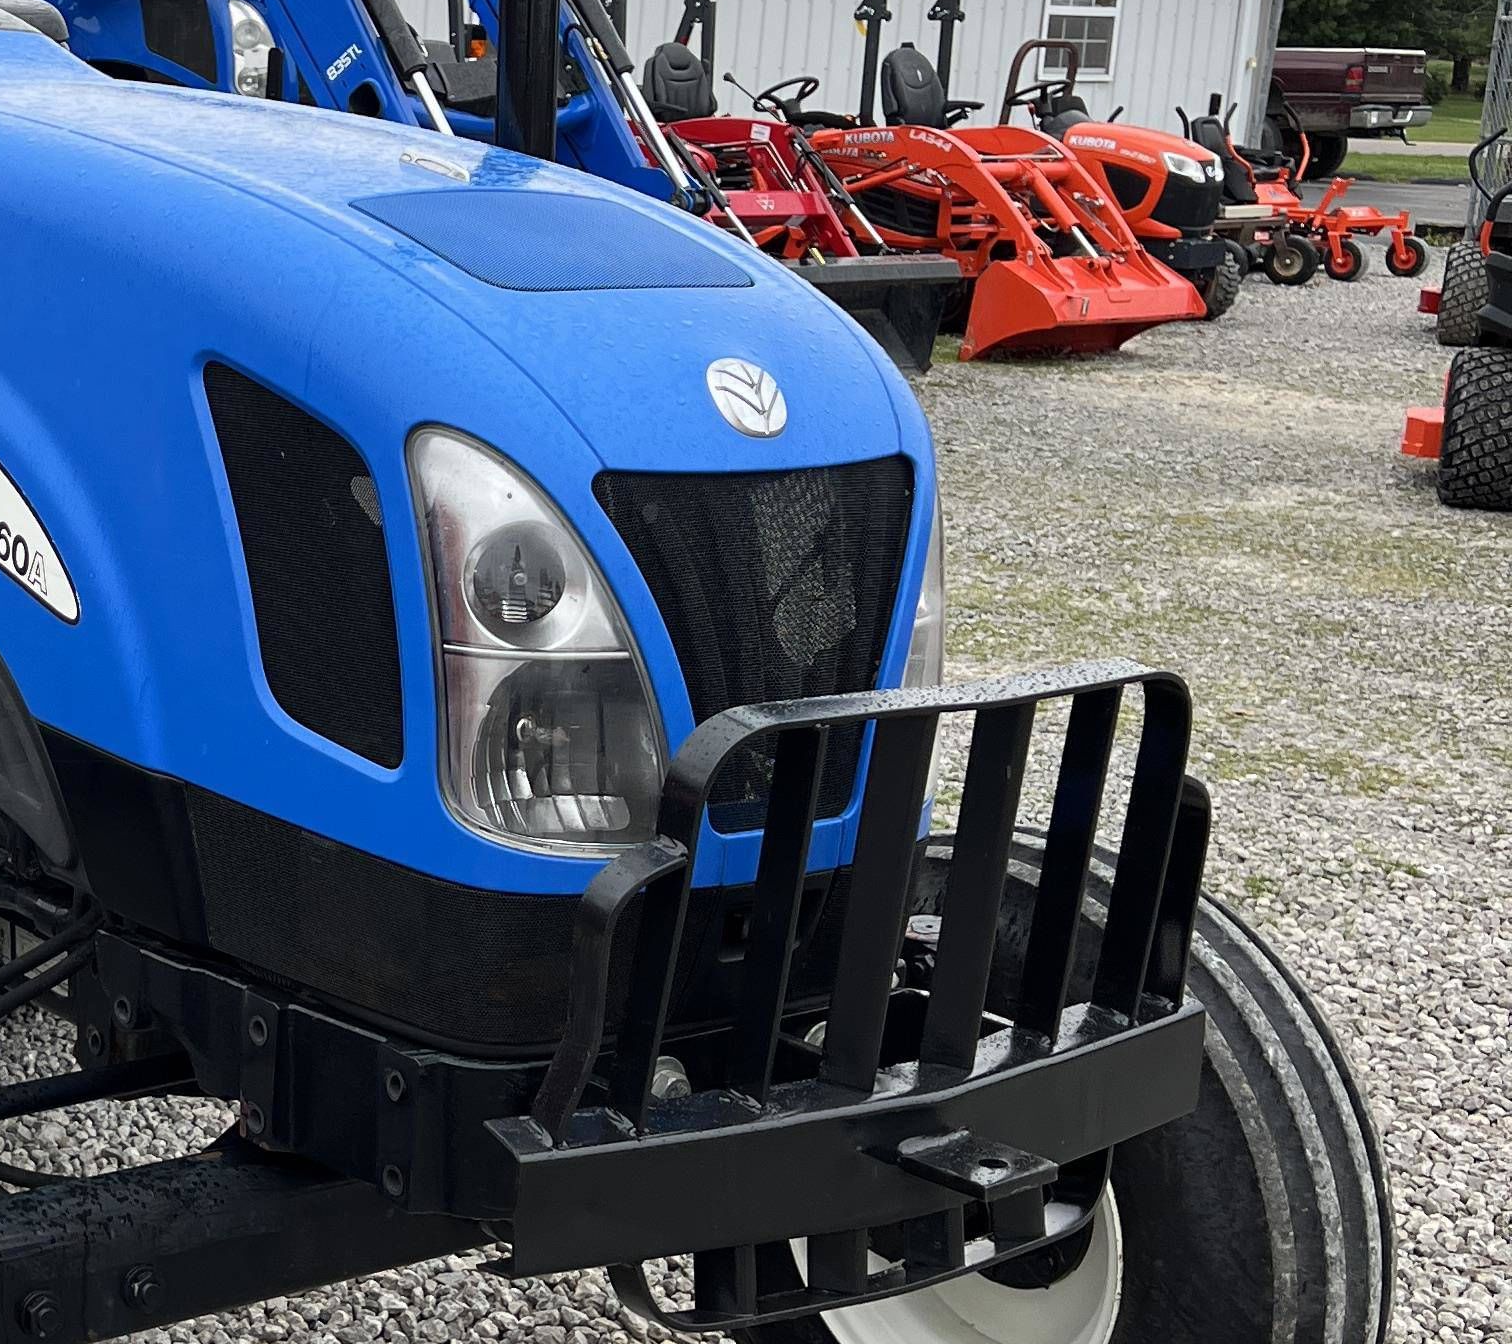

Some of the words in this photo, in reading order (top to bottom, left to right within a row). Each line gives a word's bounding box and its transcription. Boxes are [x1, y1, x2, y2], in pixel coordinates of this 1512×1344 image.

[326, 43, 363, 81] 835TL
[844, 130, 895, 146] KUBOTA
[1068, 135, 1117, 150] KUBOTA
